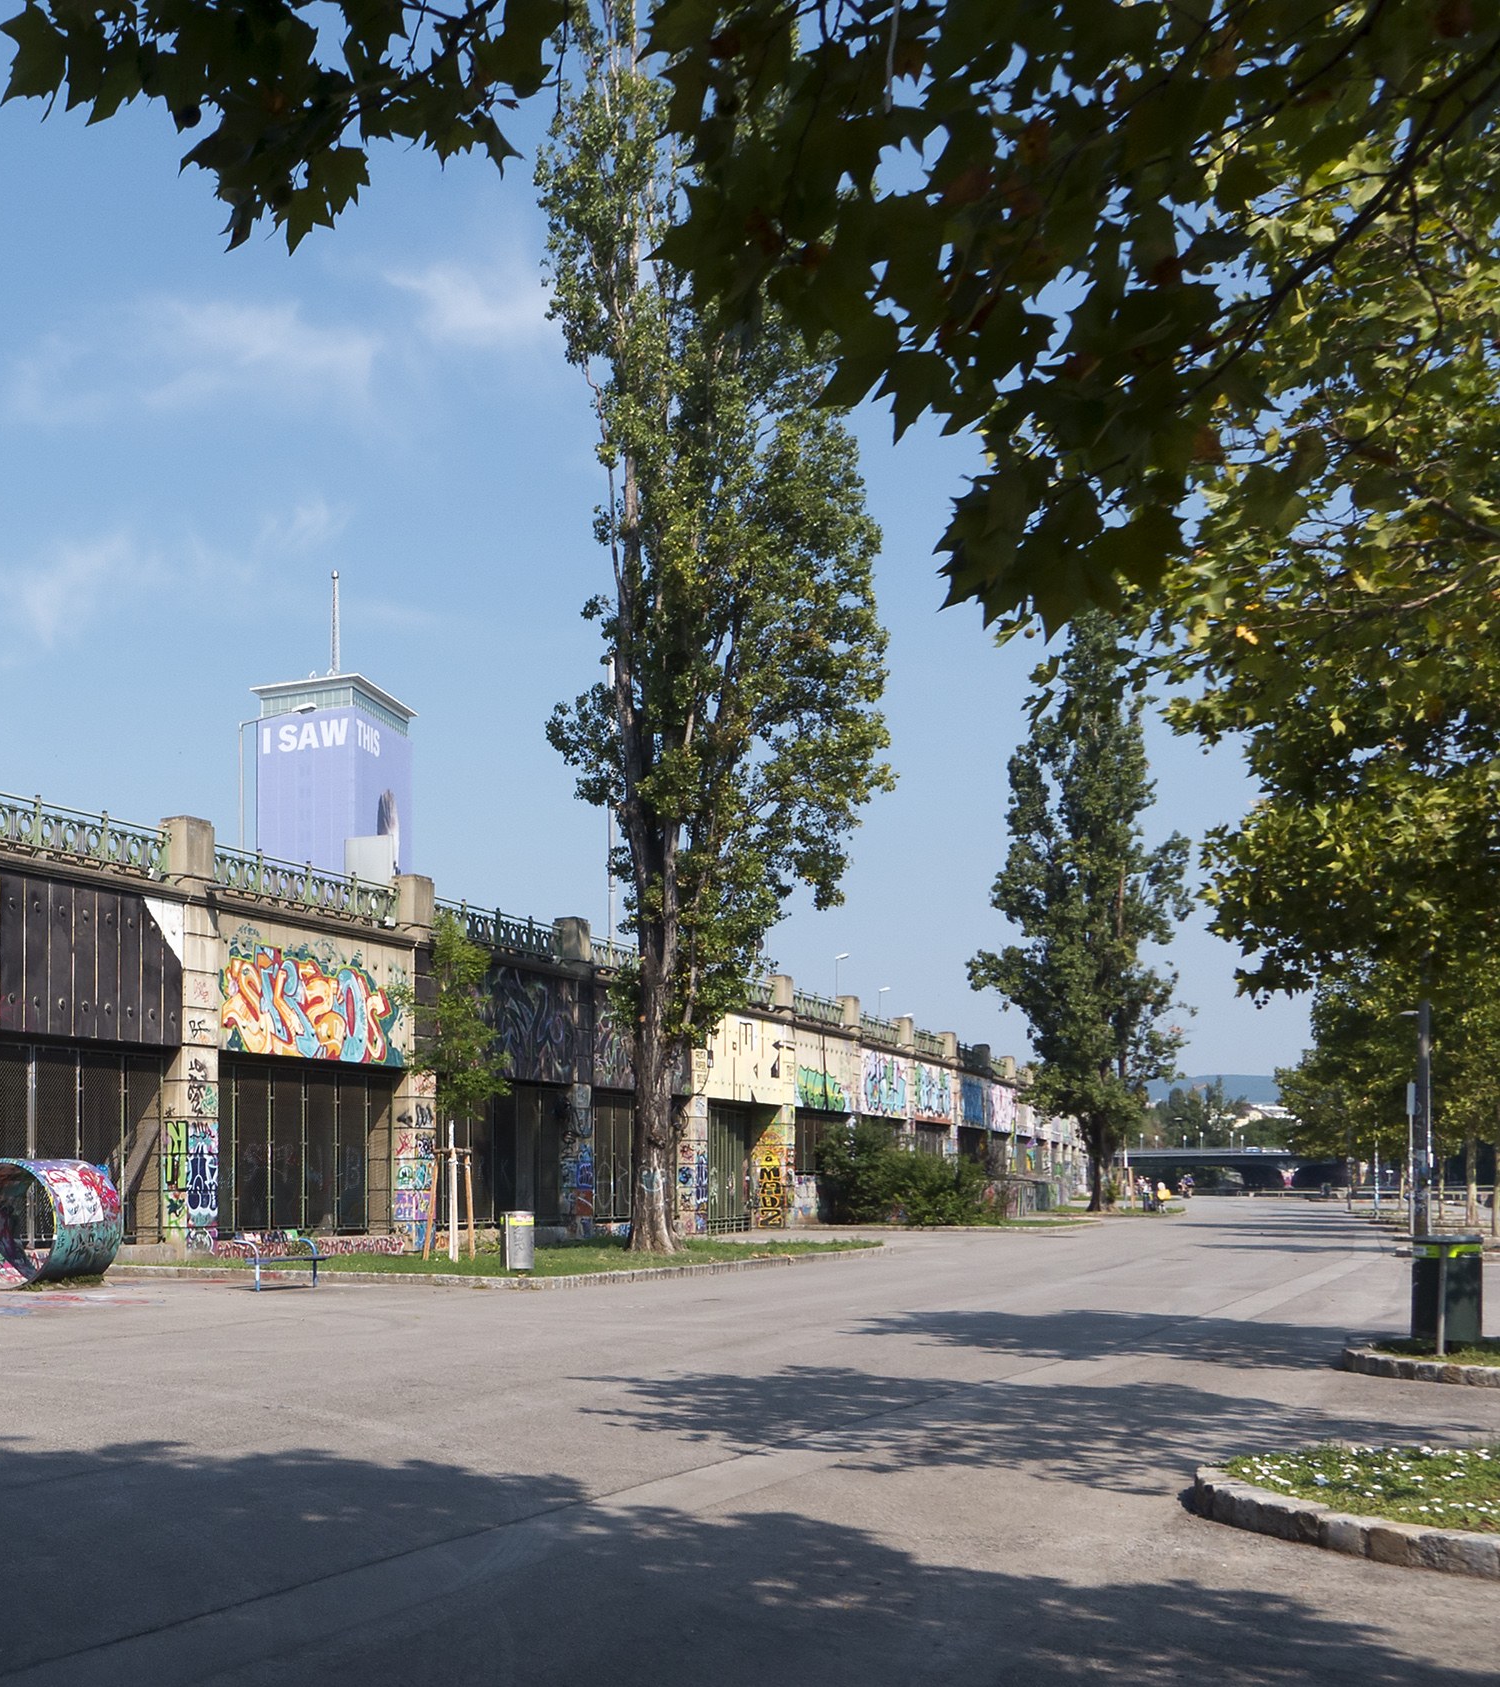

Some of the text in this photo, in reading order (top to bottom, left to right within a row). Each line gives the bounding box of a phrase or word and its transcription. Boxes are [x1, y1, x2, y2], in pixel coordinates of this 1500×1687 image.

[262, 717, 381, 757] I SAW THIS
